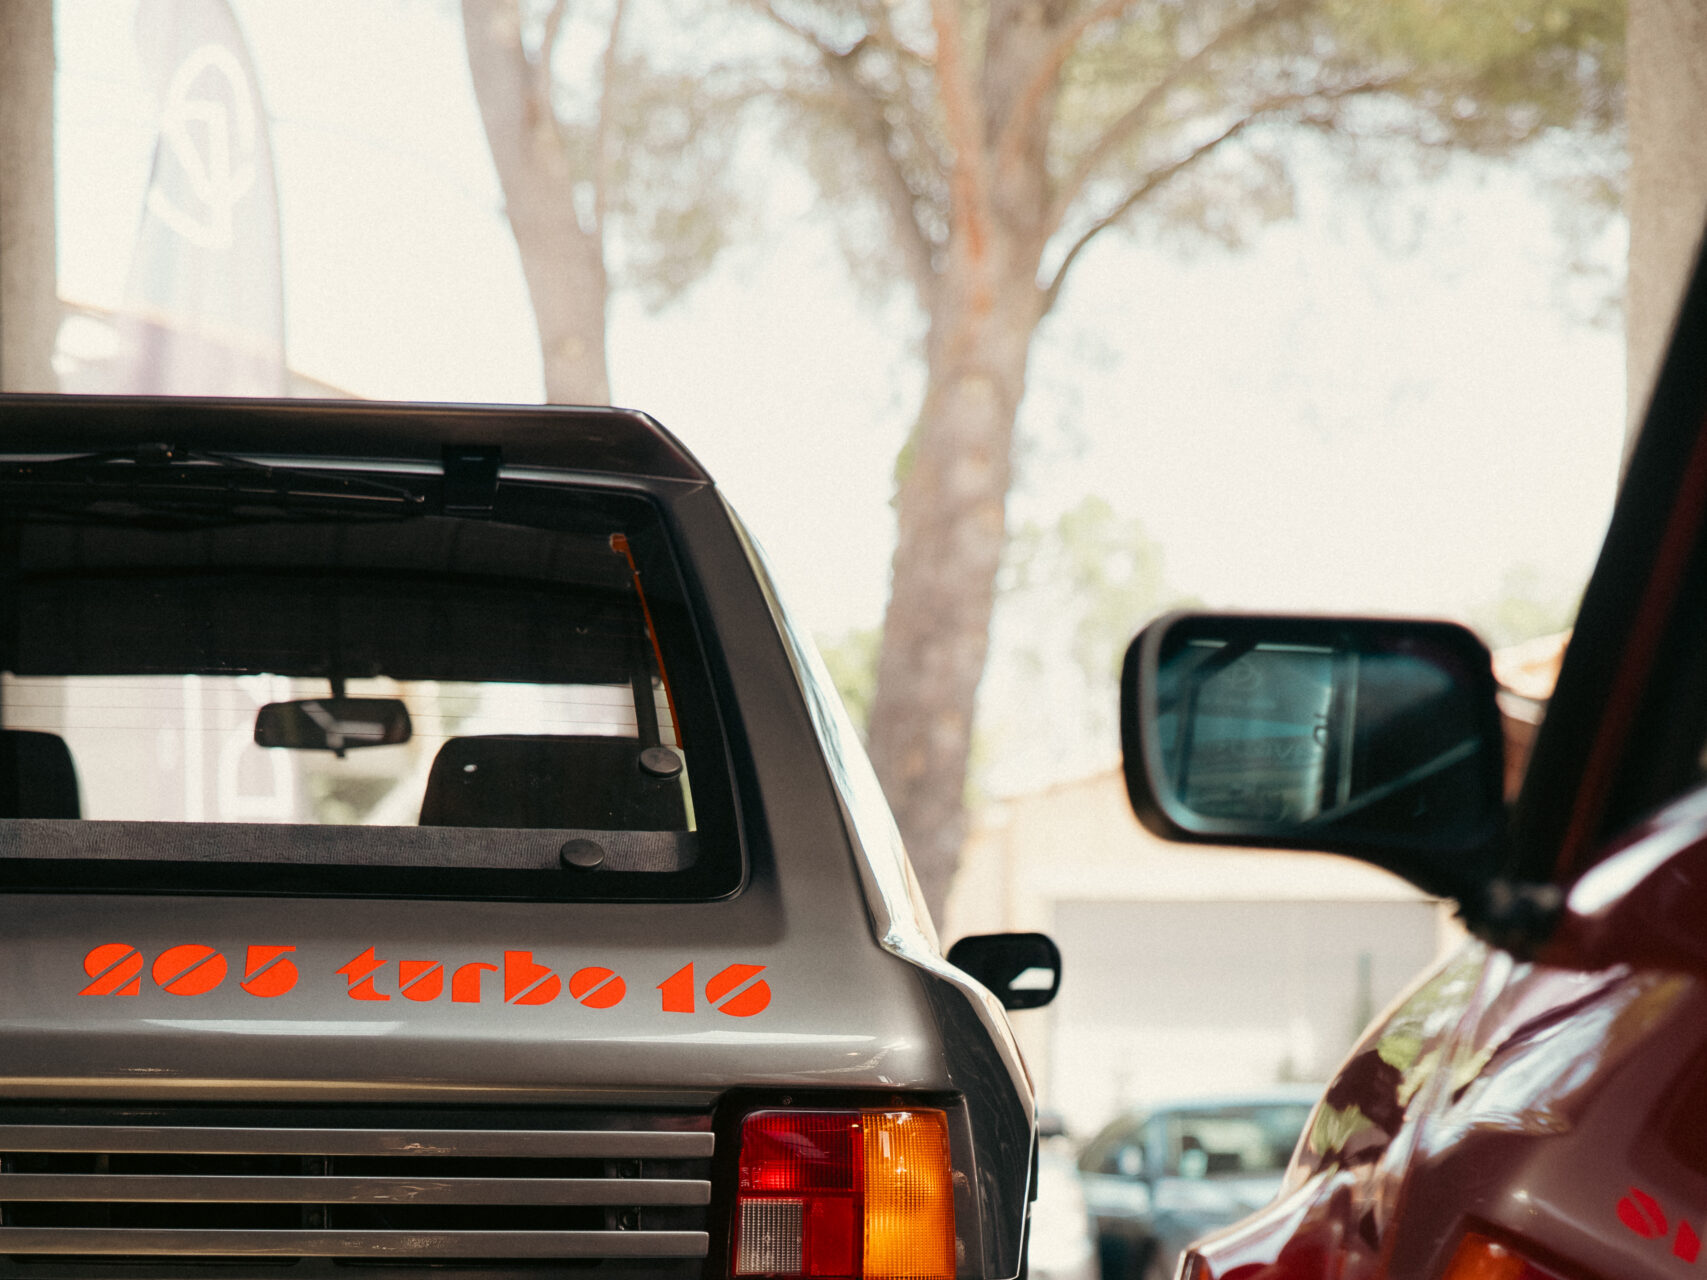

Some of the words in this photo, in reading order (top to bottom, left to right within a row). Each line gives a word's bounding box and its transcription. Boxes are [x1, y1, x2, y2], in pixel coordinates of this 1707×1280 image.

[77, 943, 298, 998] 205
[335, 945, 627, 1009] turbo
[656, 961, 772, 1018] 16
